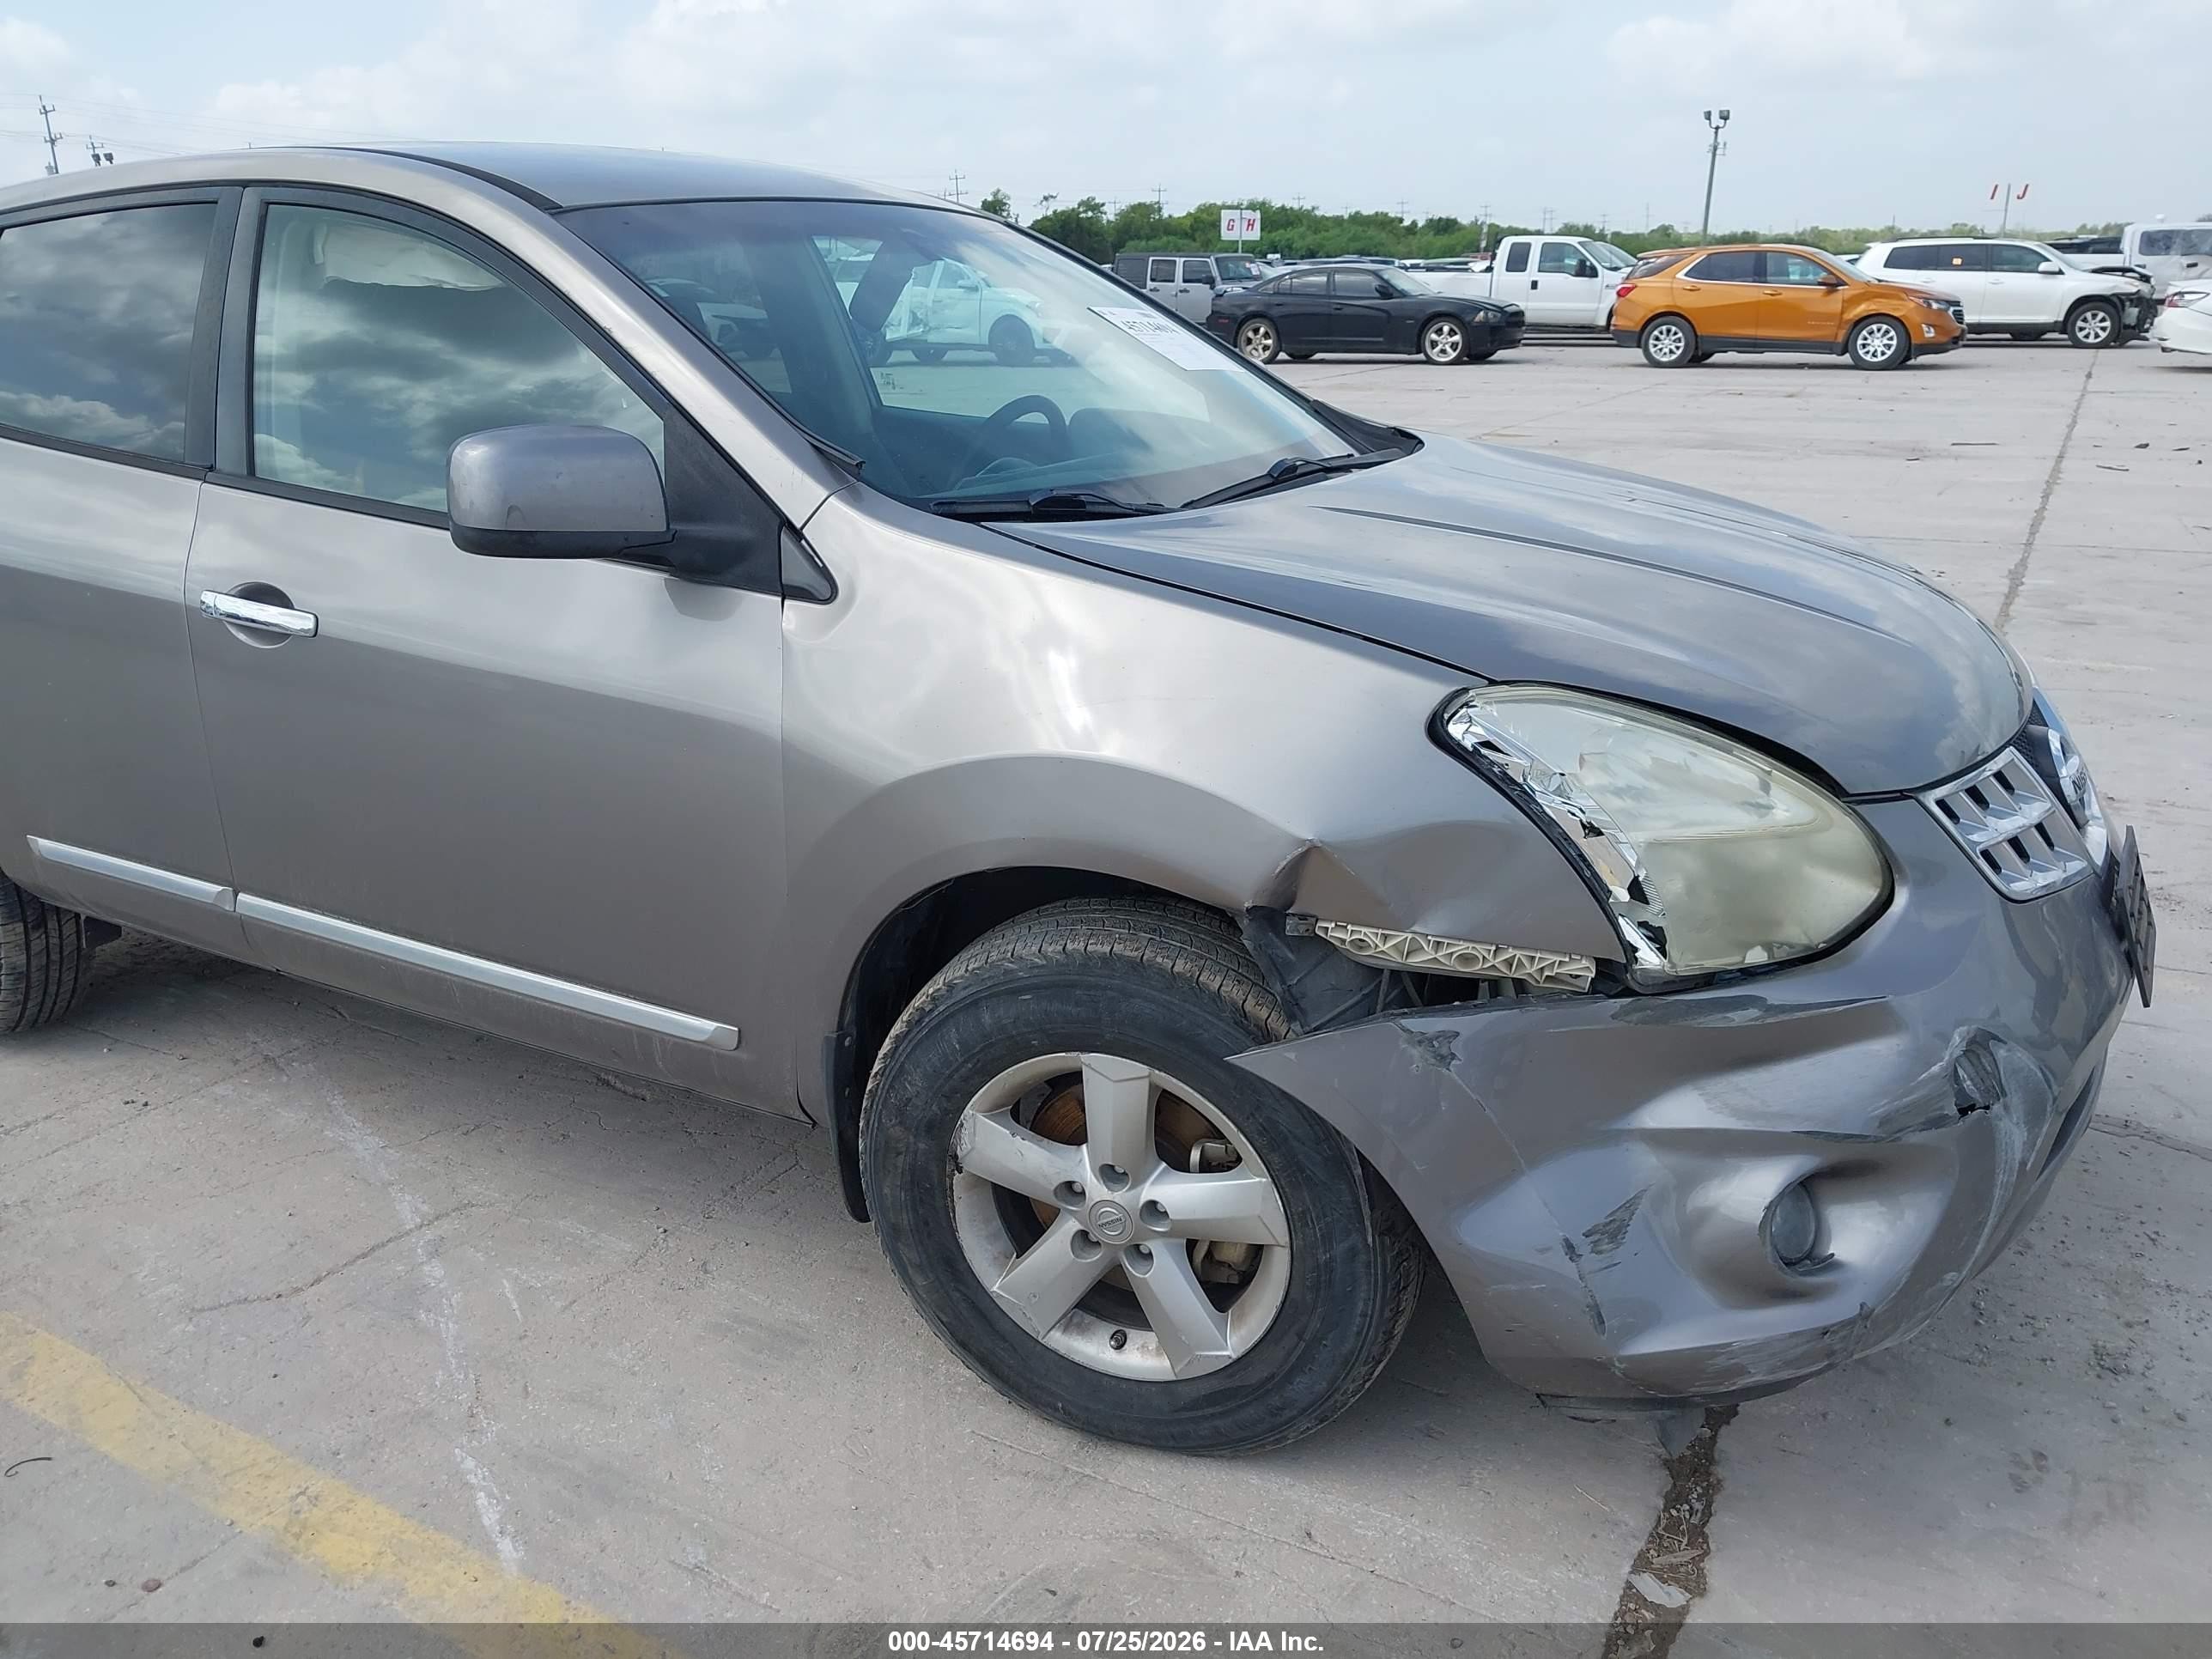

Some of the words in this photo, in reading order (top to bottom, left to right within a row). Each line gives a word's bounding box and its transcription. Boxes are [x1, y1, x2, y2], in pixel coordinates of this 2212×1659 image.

[2016, 183, 2029, 199] J
[1226, 218, 1235, 231] G
[1246, 218, 1255, 231] H
[1098, 1216, 1122, 1229] NISSAN
